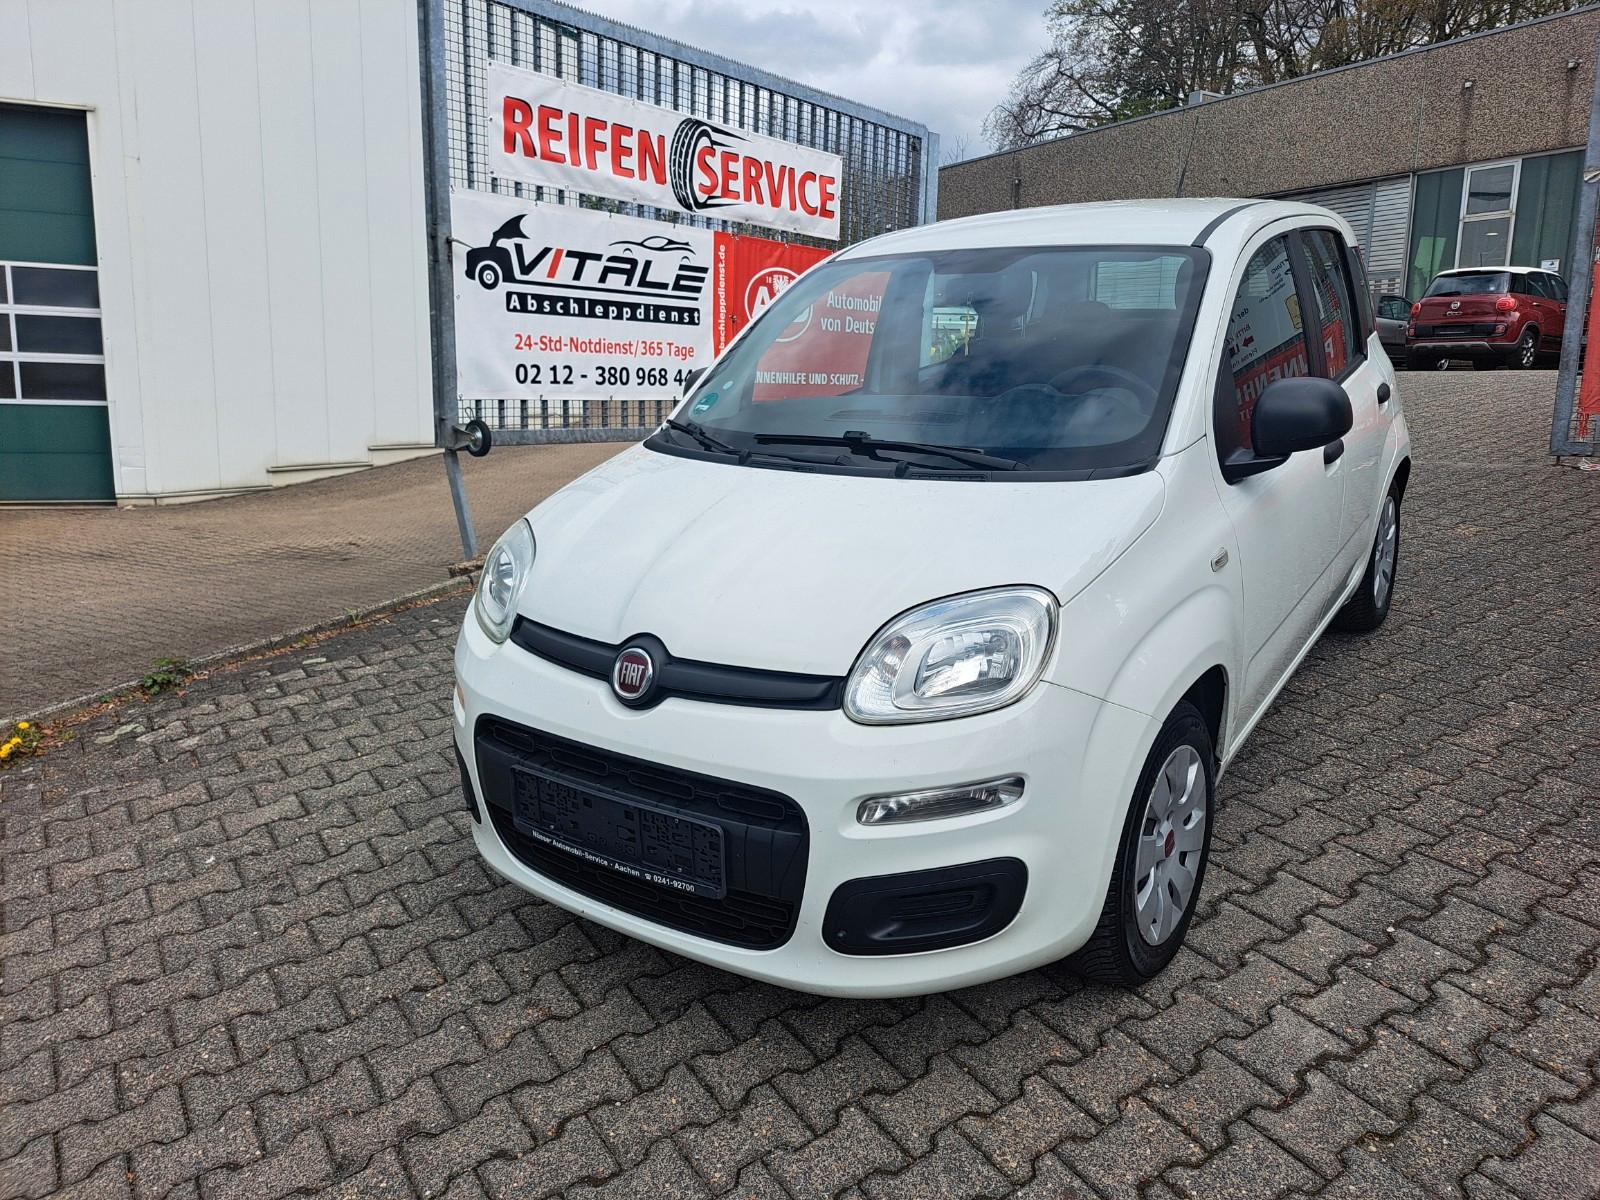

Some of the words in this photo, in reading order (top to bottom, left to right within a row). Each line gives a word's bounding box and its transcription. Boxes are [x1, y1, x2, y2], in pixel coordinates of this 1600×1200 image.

[503, 95, 667, 185] REIFEN
[697, 146, 836, 218] SERVICE
[514, 242, 709, 294] VITALE
[509, 293, 699, 324] Abschleppdienst
[718, 244, 727, 350] bschleppdienst.de
[820, 317, 840, 331] von
[514, 333, 663, 358] 24-Std-Notdienst/365
[667, 342, 695, 361] Tage
[515, 363, 541, 384] 02
[549, 364, 574, 385] 12
[595, 366, 630, 386] 380
[636, 367, 668, 387] 968
[809, 372, 828, 385] UND
[830, 373, 859, 386] SCHUTZ
[620, 661, 645, 687] FIAT
[614, 862, 640, 877] Aachen
